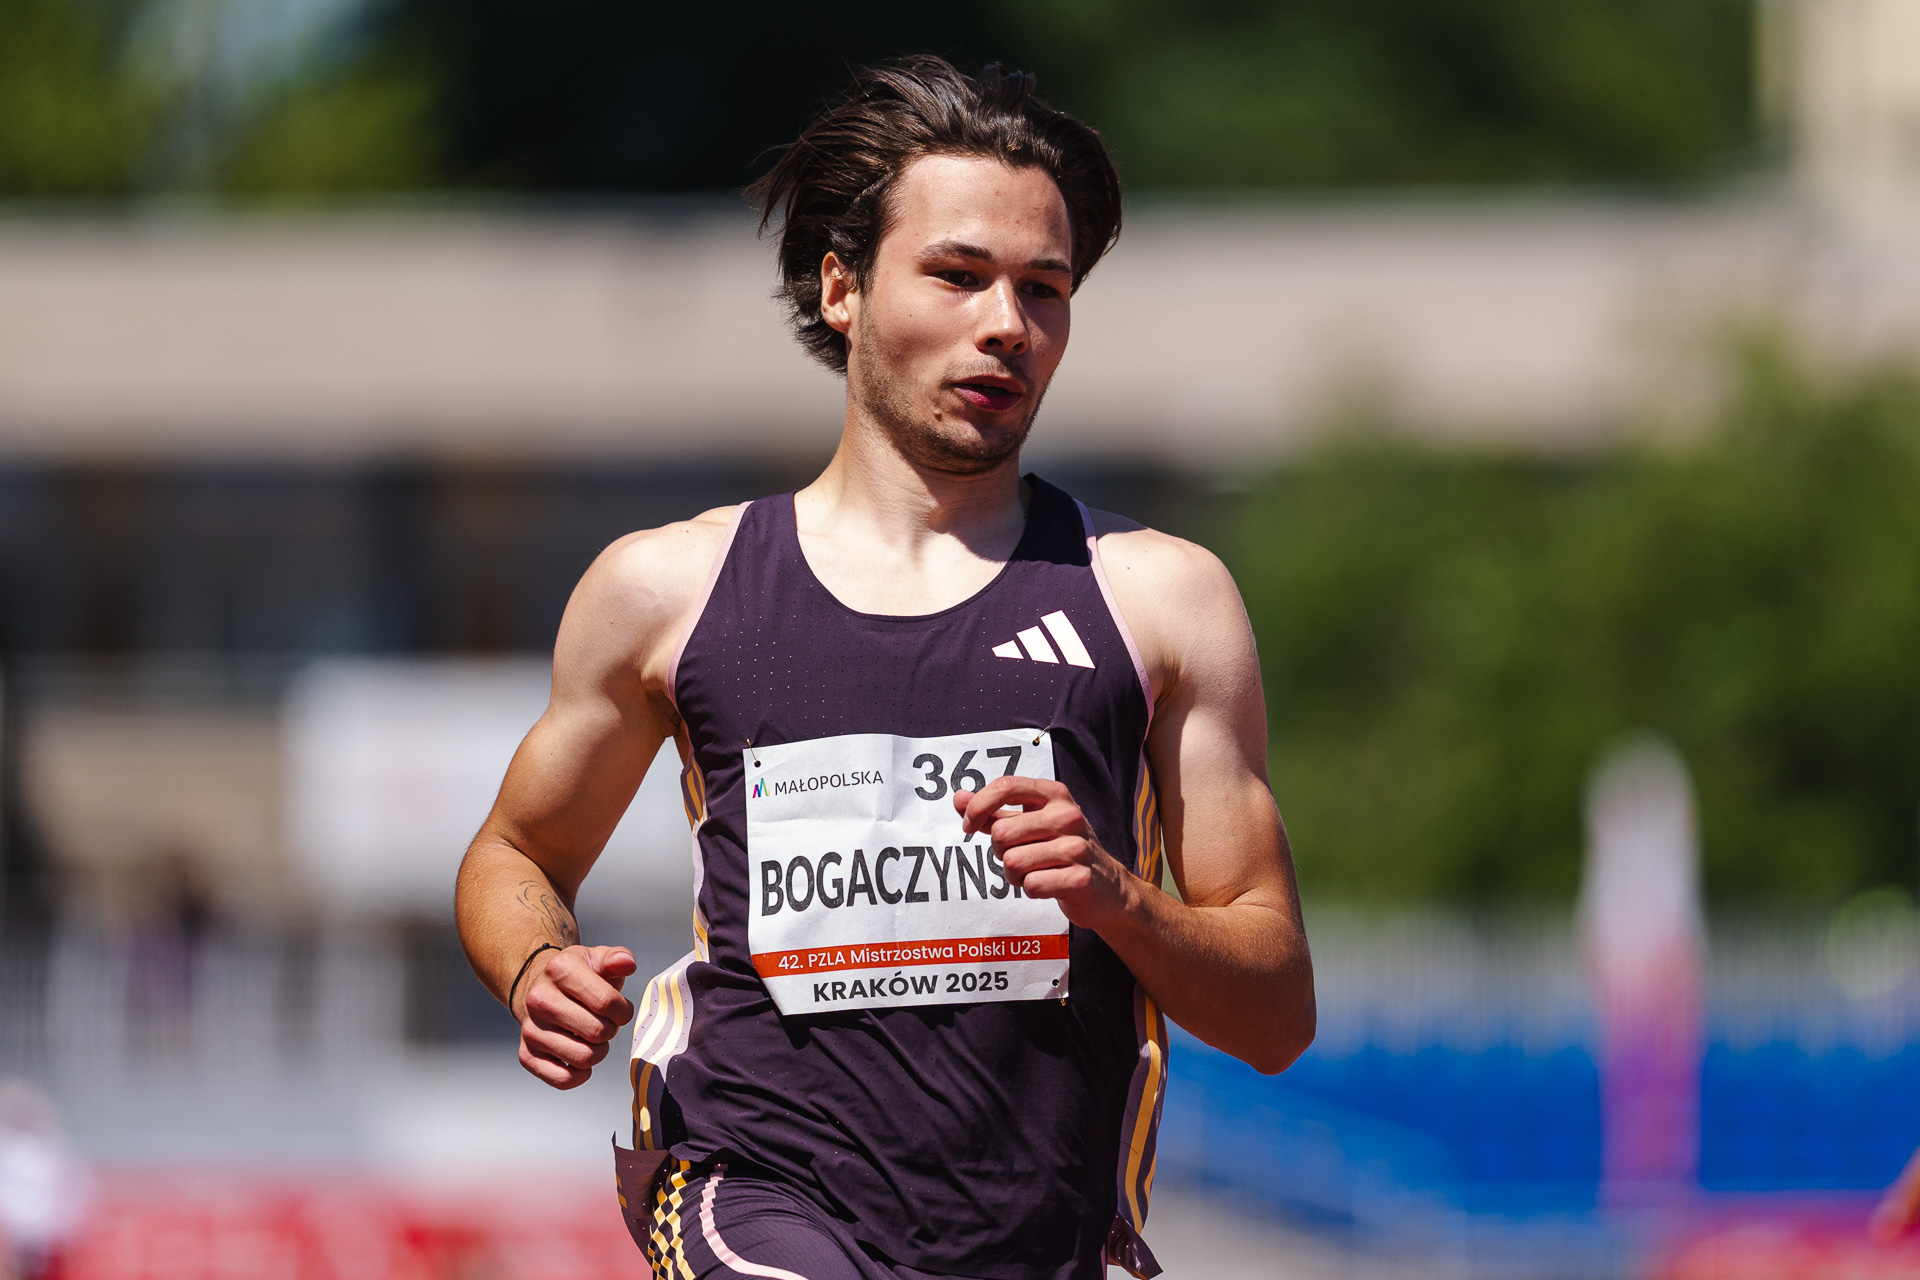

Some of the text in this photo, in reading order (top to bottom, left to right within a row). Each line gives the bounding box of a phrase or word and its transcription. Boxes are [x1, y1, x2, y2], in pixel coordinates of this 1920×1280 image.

[774, 770, 884, 796] MAŁOPOLSKA
[912, 745, 1022, 801] 367
[760, 833, 1023, 917] BOGACZYŃS
[778, 939, 1041, 970] 42. PZLA Mistrzostwa Polski U23
[813, 970, 1009, 1003] KRAKÓW 2025
